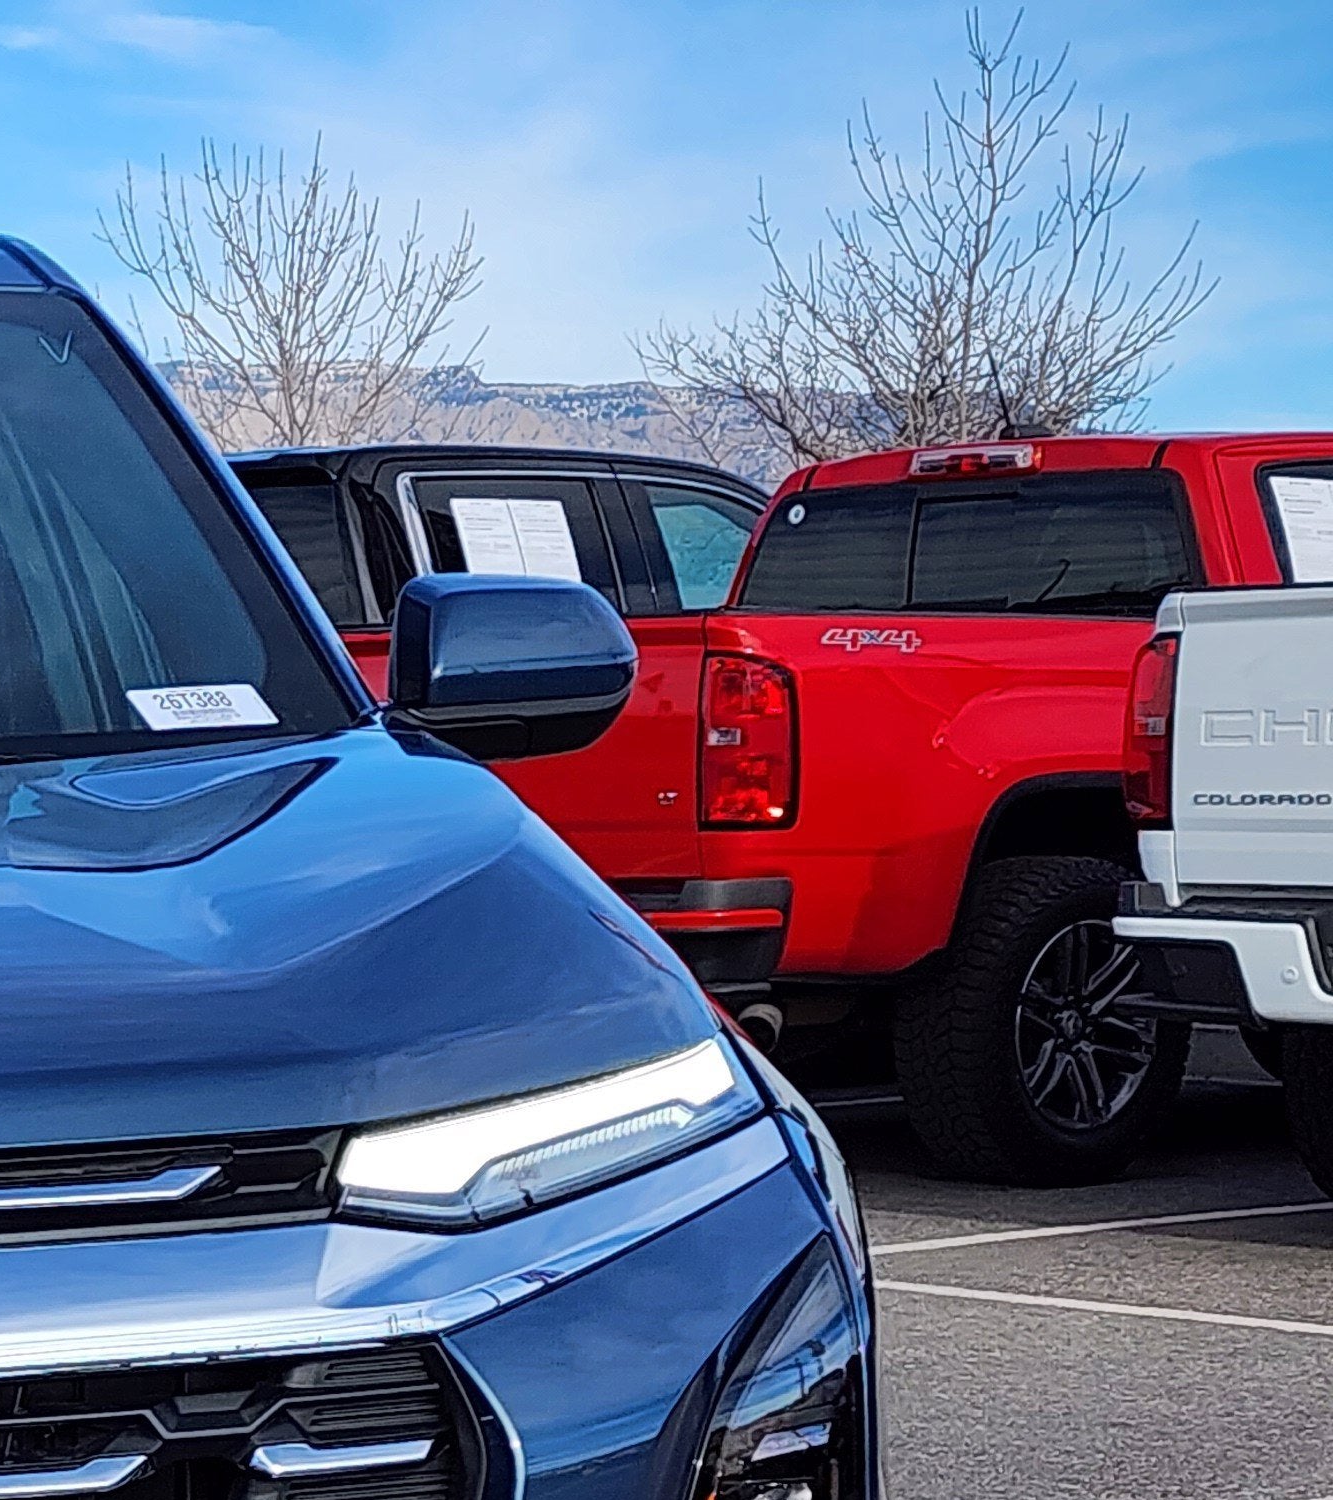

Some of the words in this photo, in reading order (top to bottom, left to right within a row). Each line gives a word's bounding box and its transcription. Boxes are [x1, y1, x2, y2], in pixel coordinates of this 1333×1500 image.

[152, 690, 234, 711] 26T388
[1199, 708, 1333, 747] CH
[1192, 793, 1332, 806] COLORADO
